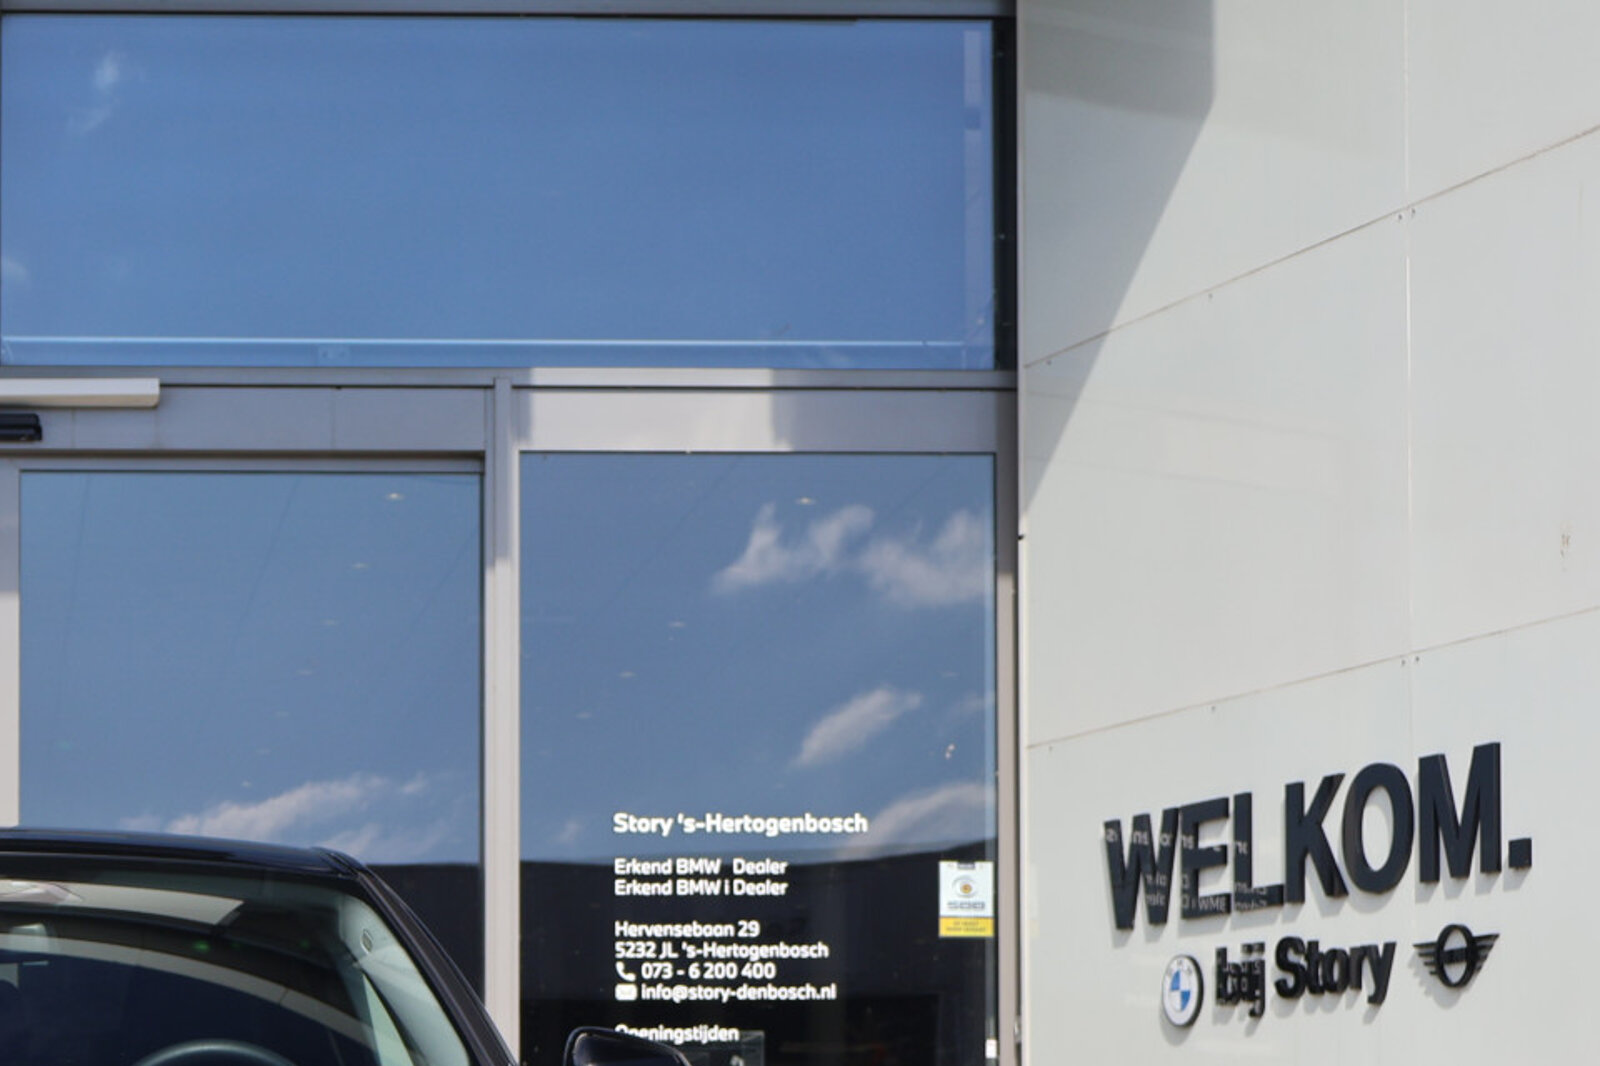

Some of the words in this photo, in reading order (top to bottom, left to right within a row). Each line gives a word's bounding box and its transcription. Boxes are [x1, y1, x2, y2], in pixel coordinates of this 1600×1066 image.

[613, 812, 674, 837] Story
[1103, 741, 1533, 932] WELKOM.
[614, 857, 673, 875] Erkend
[675, 857, 722, 875] BMW
[732, 857, 788, 875] Dealer
[614, 878, 673, 896] Erkend
[676, 878, 722, 896] BMW
[724, 878, 730, 896] i
[732, 878, 789, 896] Dealer
[614, 920, 735, 938] Hervensebaan
[737, 919, 761, 938] 29
[614, 940, 657, 959] 5232
[658, 940, 679, 959] JL
[641, 961, 674, 980] 073
[688, 961, 701, 980] 6
[703, 961, 739, 980] 200
[740, 961, 777, 980] 400
[1273, 935, 1398, 1006] Story
[641, 982, 838, 1004] info@story-denbosch.nl
